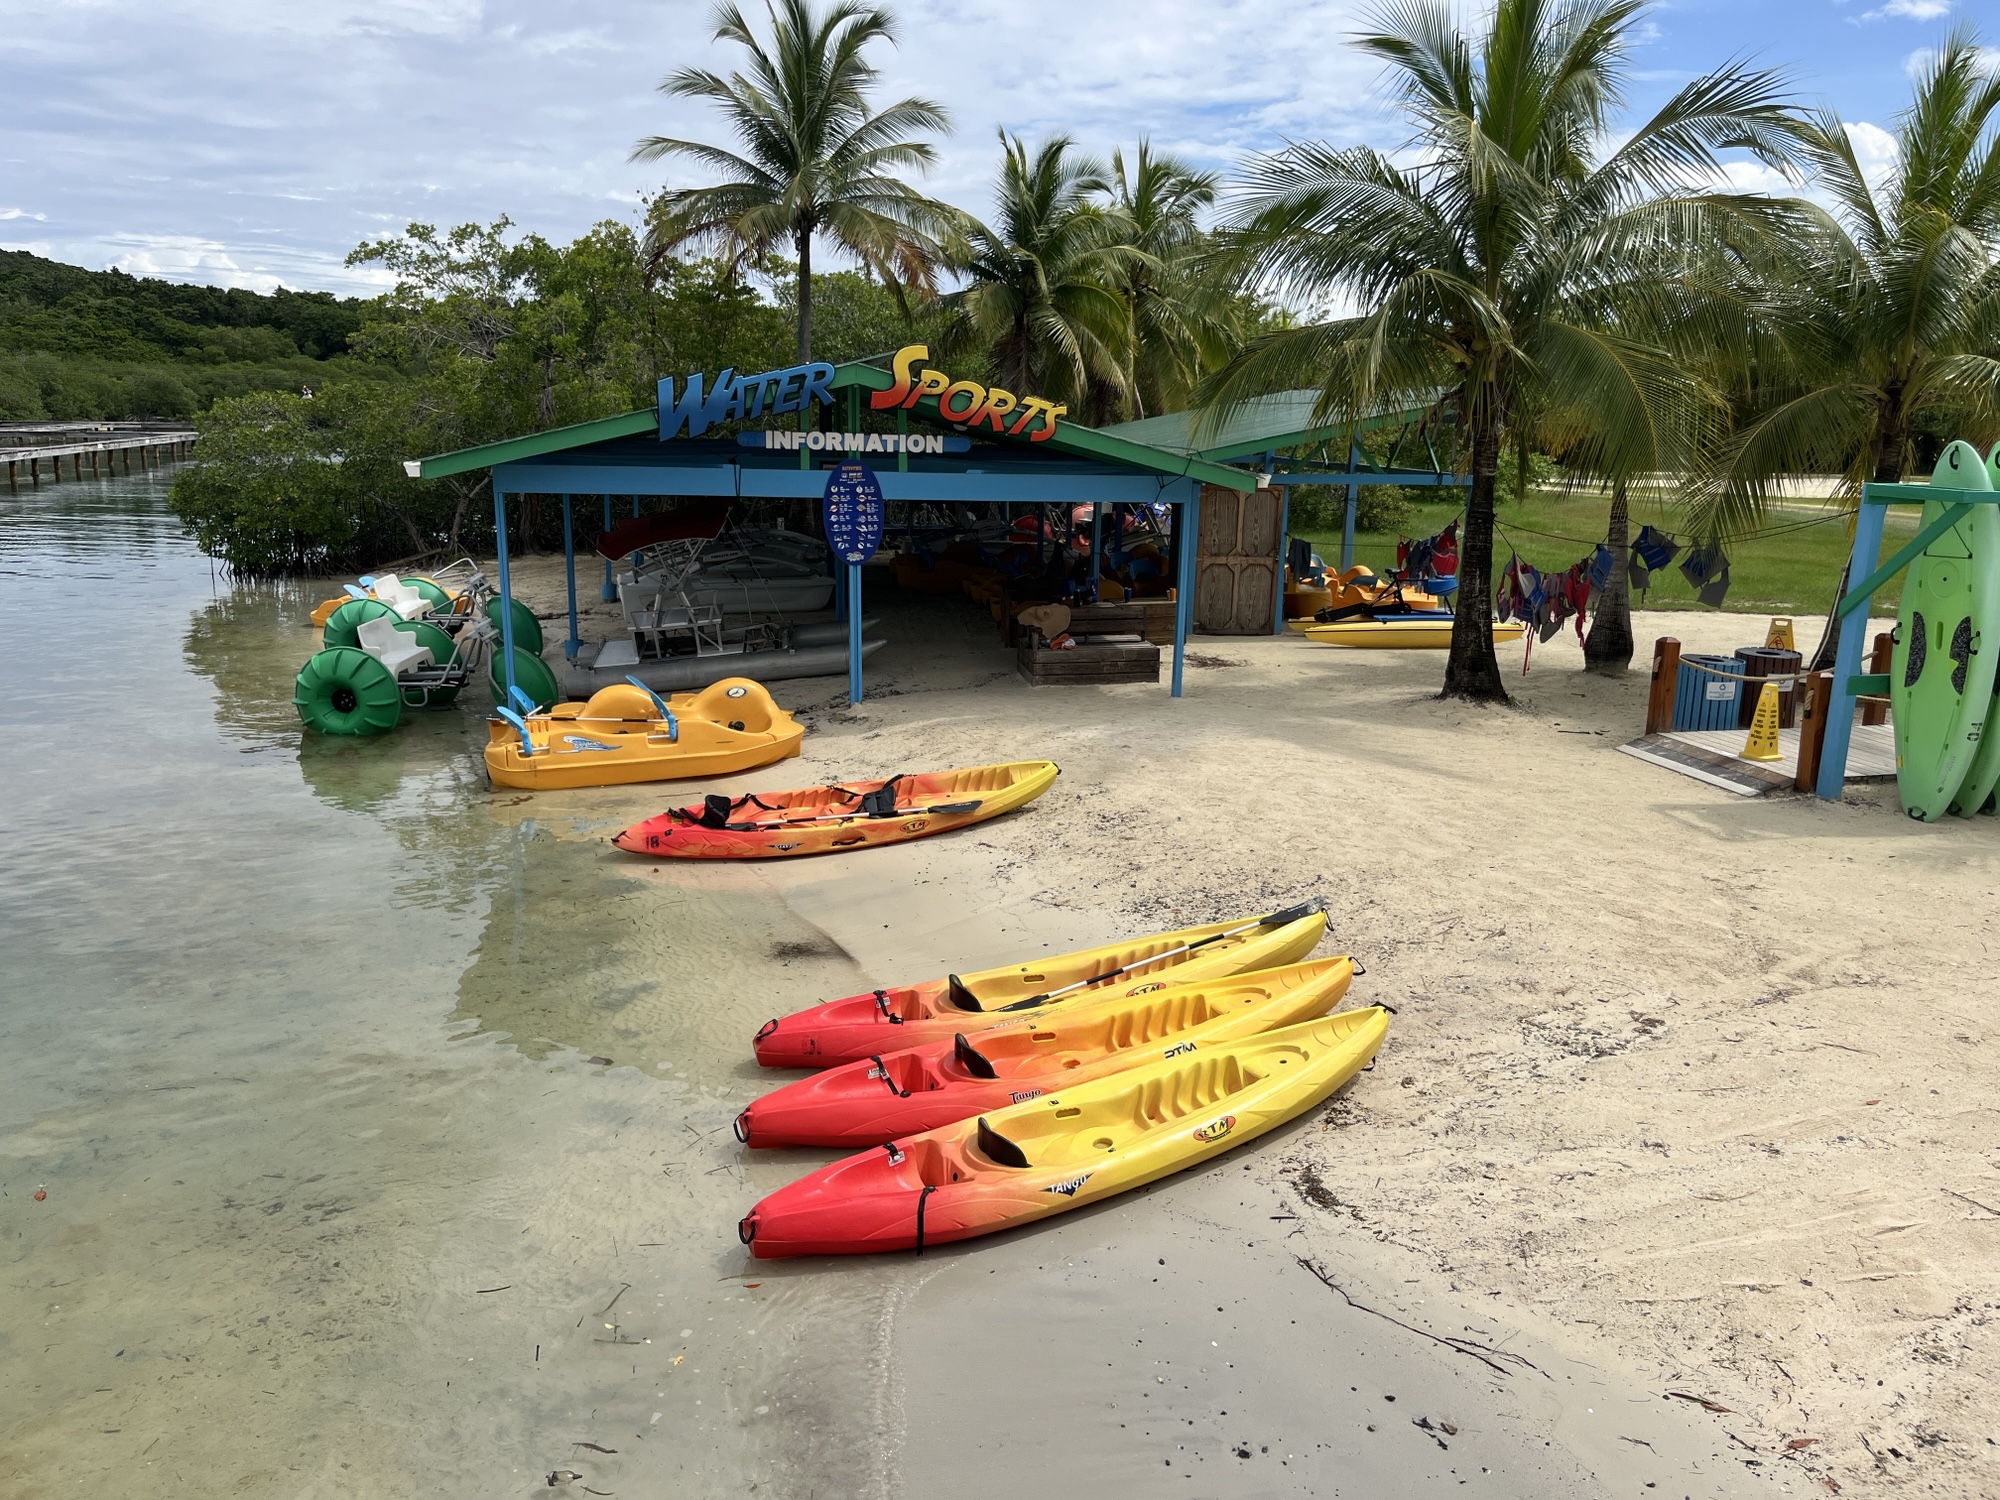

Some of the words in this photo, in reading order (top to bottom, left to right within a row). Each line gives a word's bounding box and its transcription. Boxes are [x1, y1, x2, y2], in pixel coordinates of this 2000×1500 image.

[656, 361, 836, 443] WATER
[870, 344, 1068, 442] SPORTS
[765, 430, 944, 454] INFORMATION
[1008, 1089, 1041, 1104] Tango
[1198, 1117, 1229, 1138] RTM
[1048, 1174, 1087, 1195] TANGO
